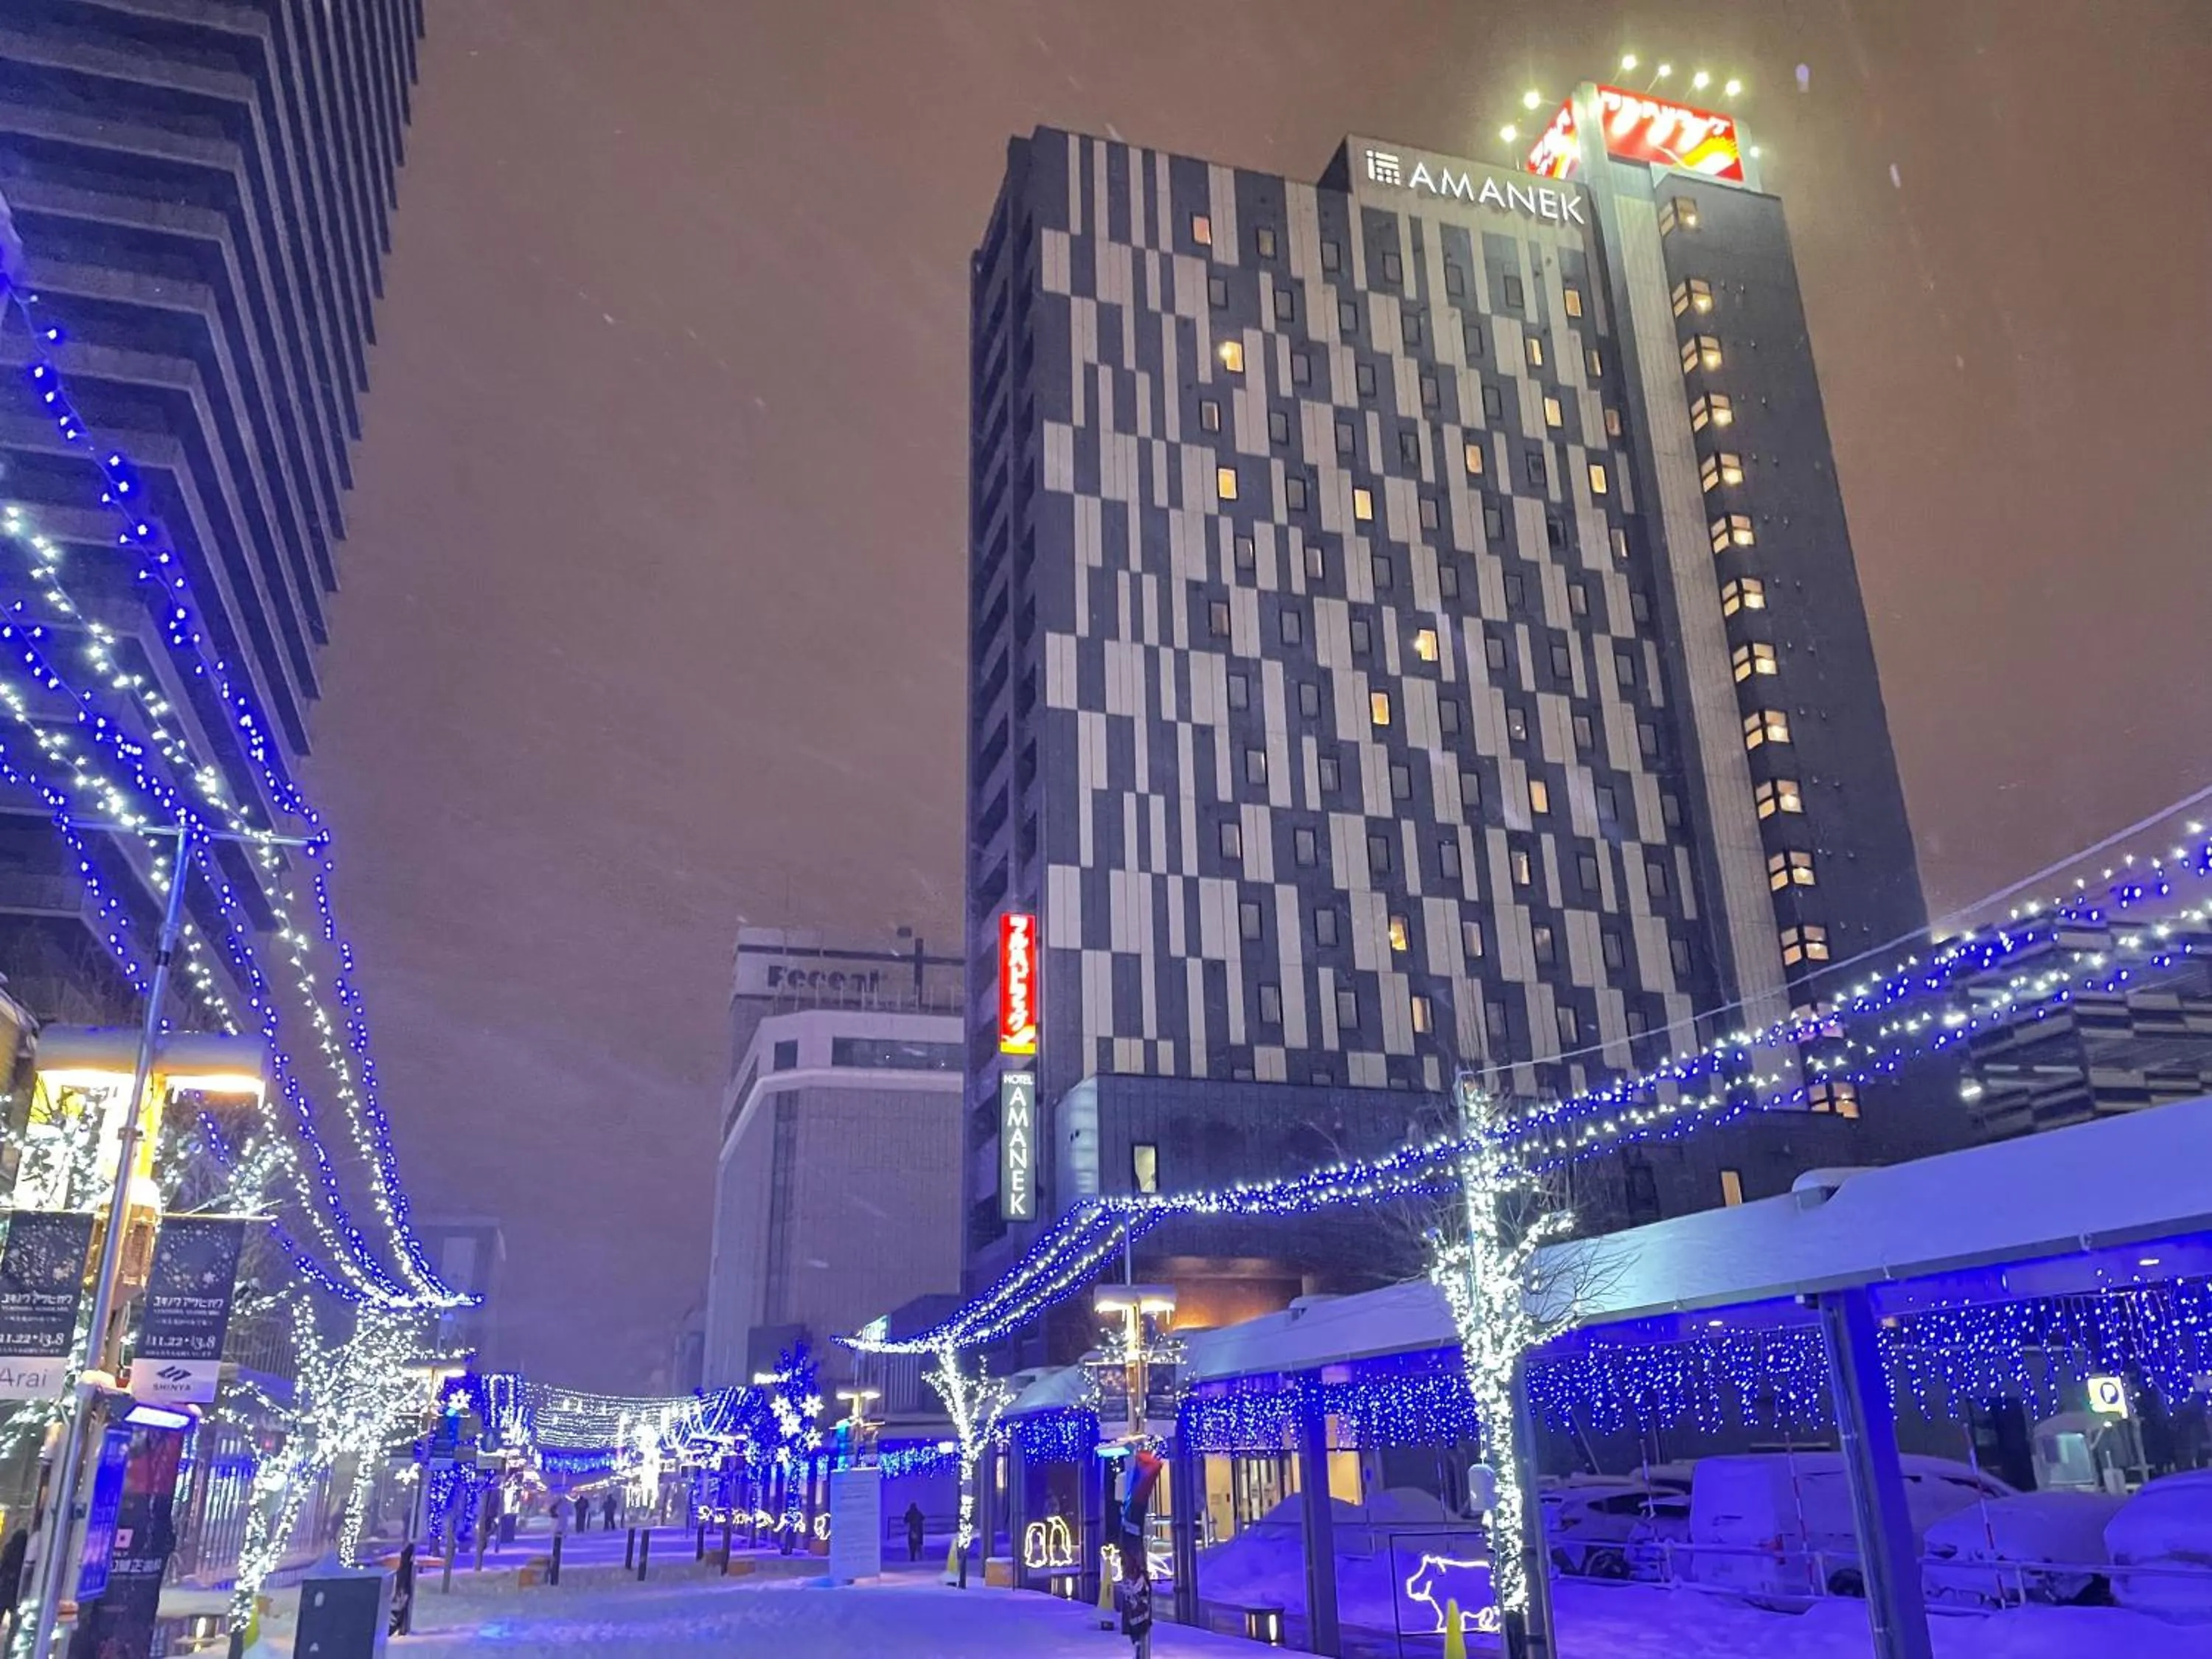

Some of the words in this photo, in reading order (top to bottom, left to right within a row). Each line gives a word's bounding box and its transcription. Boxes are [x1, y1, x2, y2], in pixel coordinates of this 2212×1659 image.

[1409, 161, 1585, 224] AMANEK
[1004, 1074, 1033, 1085] HOTEL
[1006, 1086, 1029, 1216] AMANEK
